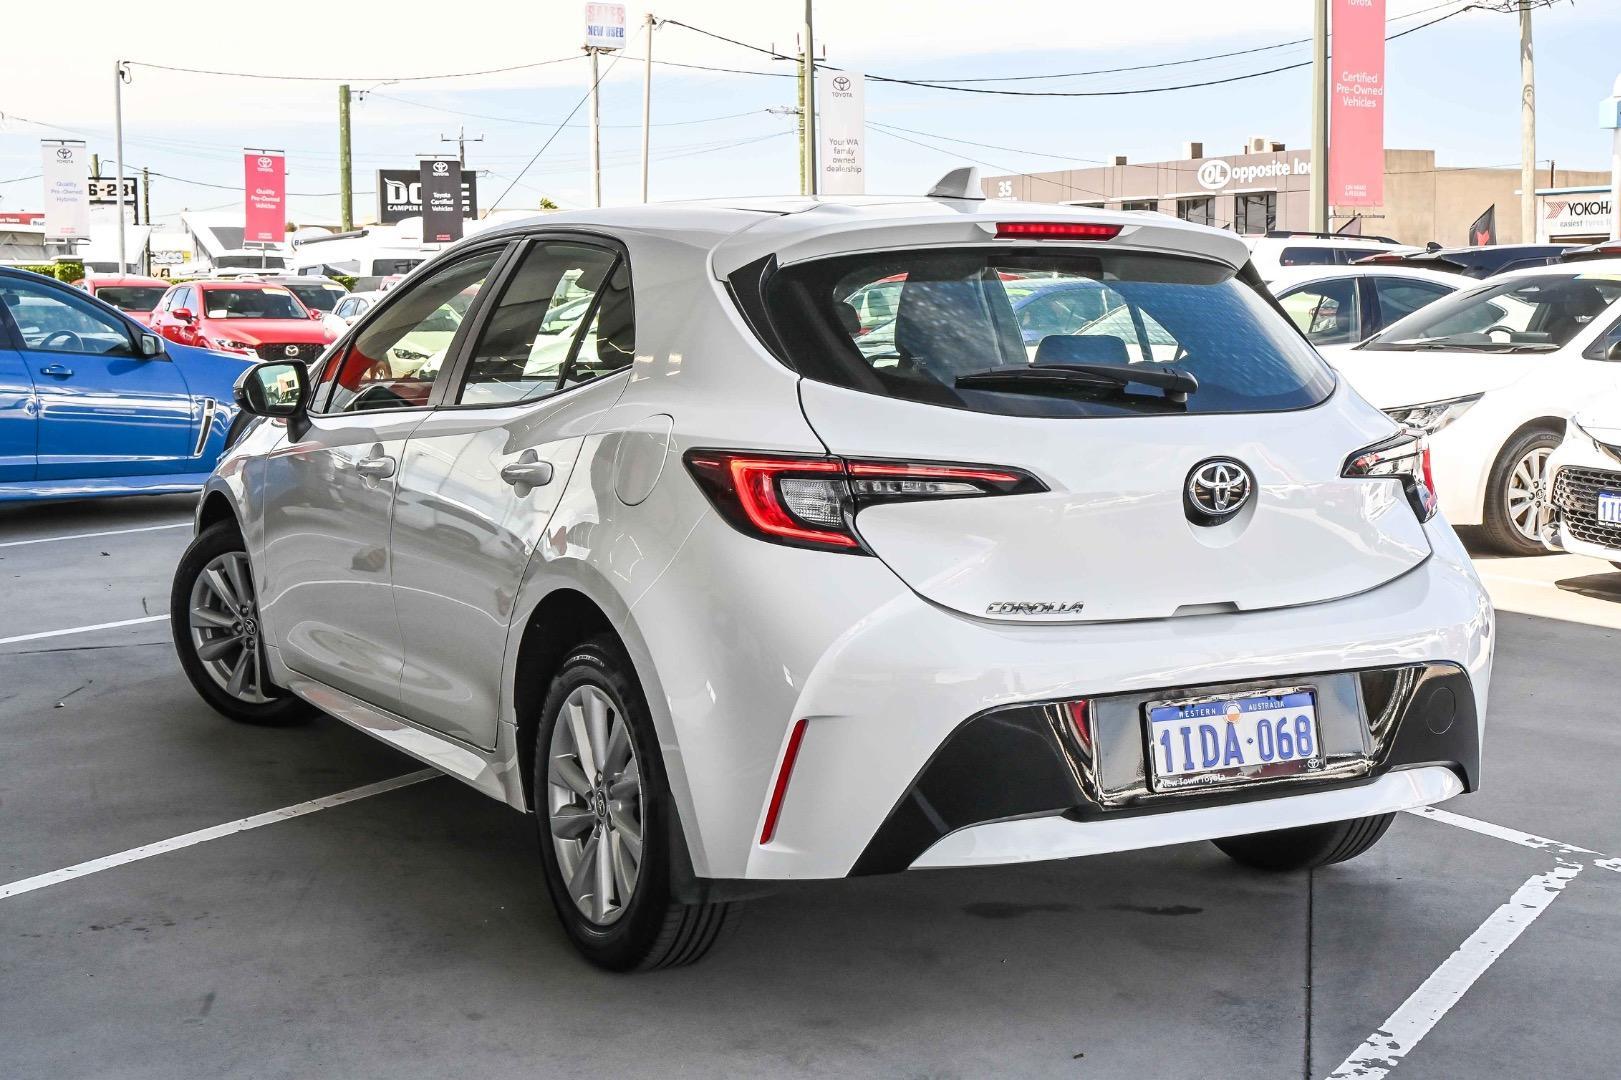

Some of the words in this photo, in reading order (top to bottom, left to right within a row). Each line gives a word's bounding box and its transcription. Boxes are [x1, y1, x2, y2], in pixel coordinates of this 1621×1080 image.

[588, 25, 603, 36] NEW
[606, 26, 624, 38] USED
[1342, 71, 1378, 83] Certified
[1336, 83, 1383, 95] Pre-Owned
[1342, 96, 1377, 108] Vehicles
[829, 138, 845, 146] Your
[846, 138, 859, 146] WA
[833, 146, 855, 157] family
[826, 165, 862, 175] dealership
[1231, 160, 1290, 184] opposite
[1293, 158, 1312, 175] lo
[256, 188, 275, 196] Quality
[998, 181, 1012, 198] 35
[251, 194, 281, 203] Pre-Owned
[985, 600, 1084, 616] COROLLA
[1178, 707, 1216, 719] WESTERN
[1248, 701, 1285, 712] AUSTRALIA
[1200, 773, 1227, 784] Toyota
